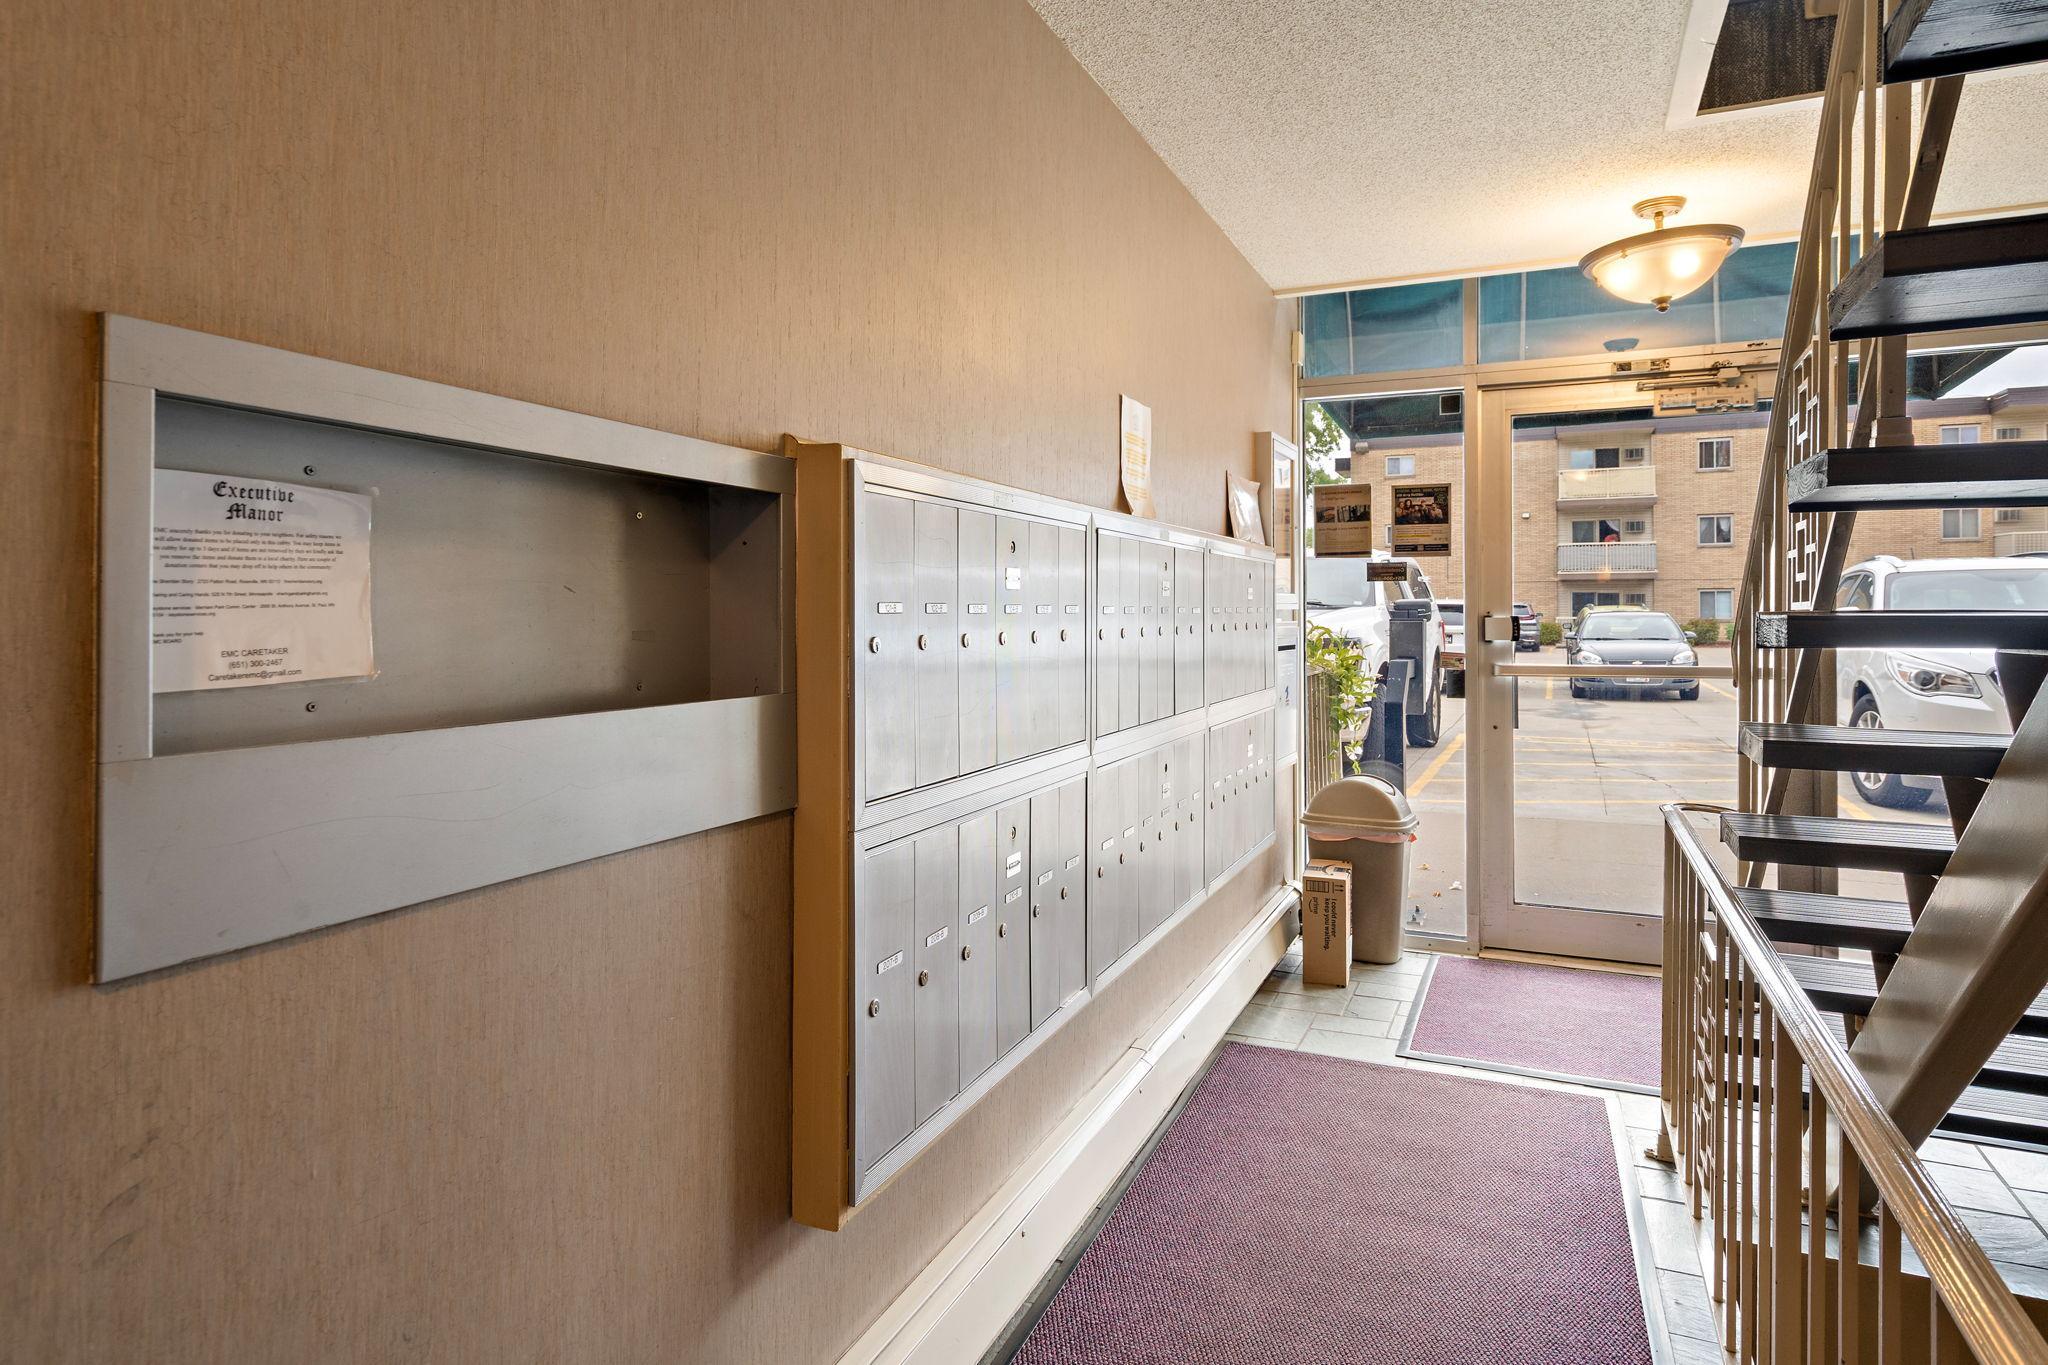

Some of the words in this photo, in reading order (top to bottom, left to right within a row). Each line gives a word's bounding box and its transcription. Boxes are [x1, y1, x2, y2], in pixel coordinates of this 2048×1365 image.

[213, 481, 295, 503] Executive
[226, 503, 284, 522] Manor
[221, 650, 239, 658] EMC
[241, 647, 289, 657] CARETAKER
[229, 660, 248, 670] (651)
[208, 669, 303, 682] Caretakeremc@gmail.com
